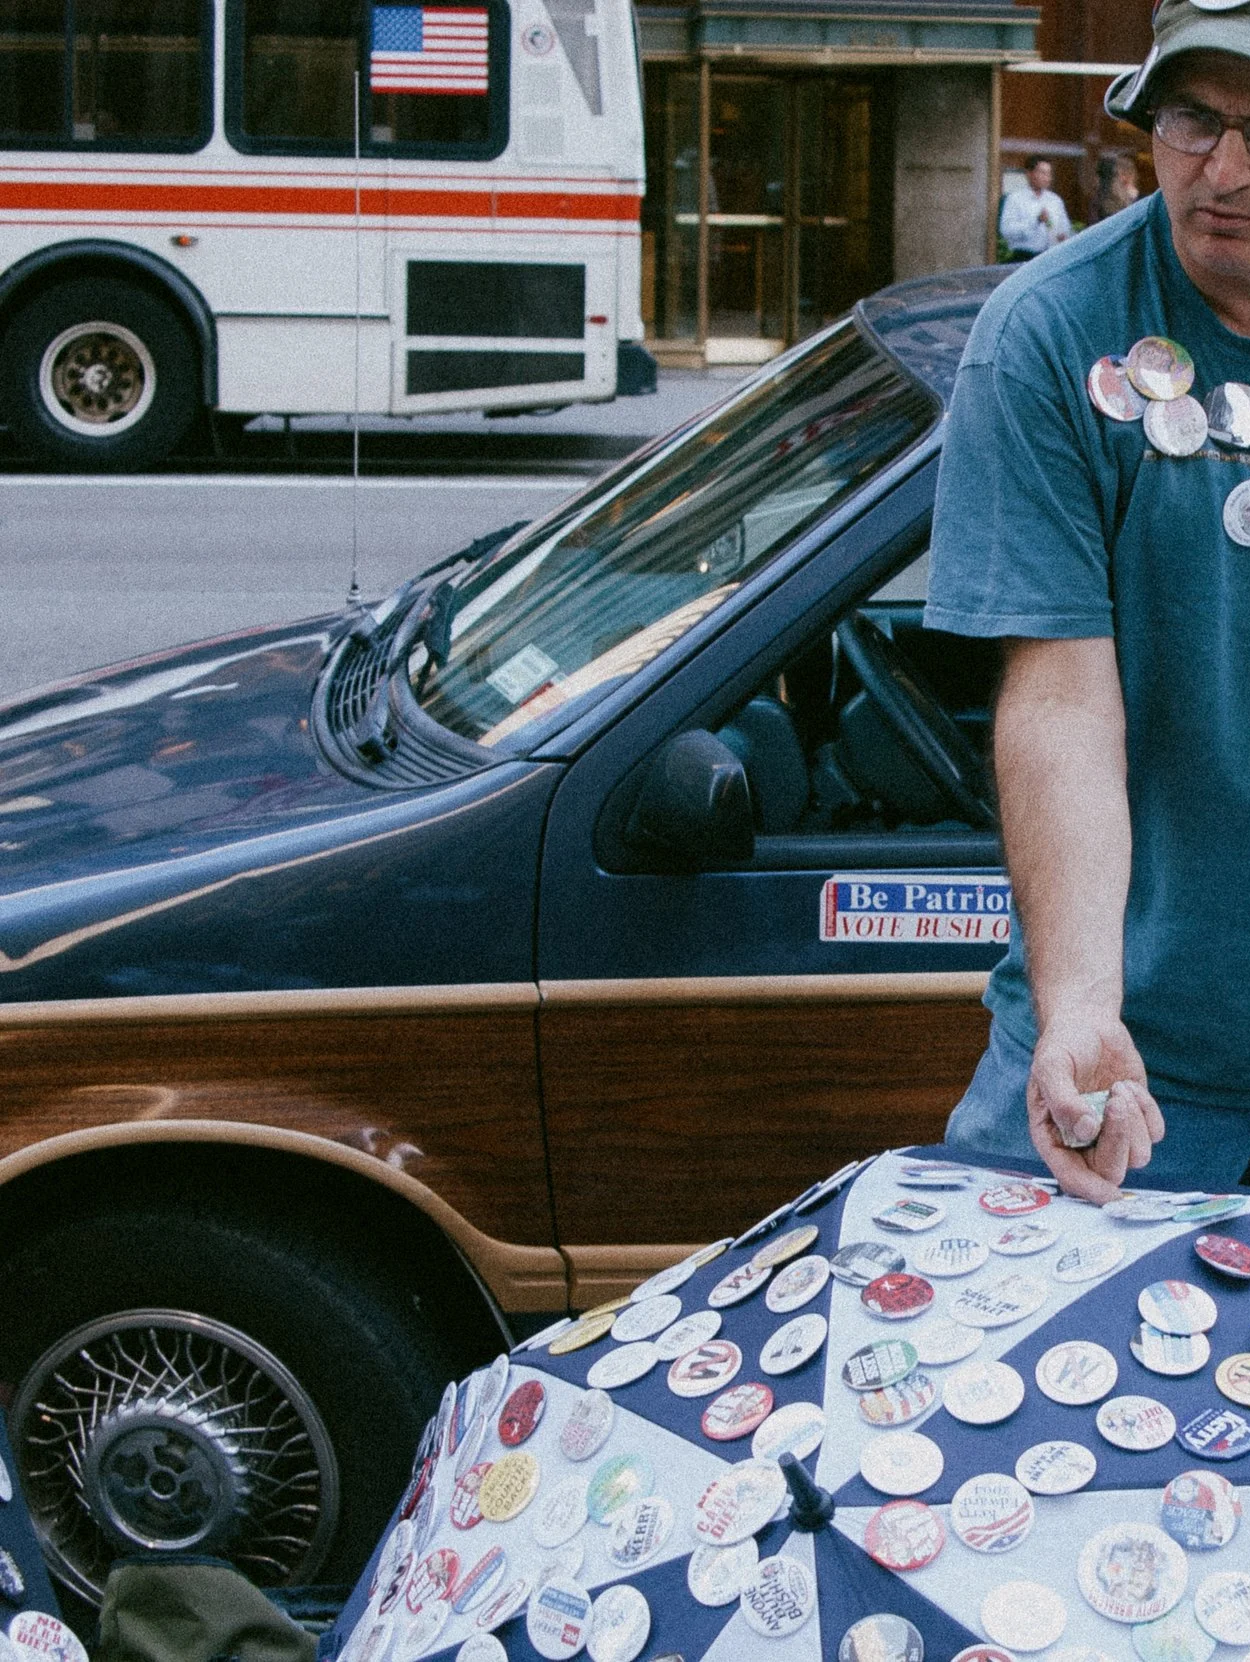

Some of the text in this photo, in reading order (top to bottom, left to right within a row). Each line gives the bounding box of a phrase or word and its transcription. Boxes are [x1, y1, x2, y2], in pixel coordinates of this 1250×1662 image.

[850, 883, 889, 911] Be
[842, 916, 904, 939] VOTE
[915, 916, 983, 939] BUSH
[1184, 1409, 1246, 1450] Kerry
[629, 1502, 653, 1558] KERRY
[37, 1615, 62, 1632] NO
[742, 1585, 782, 1632] ANYONE
